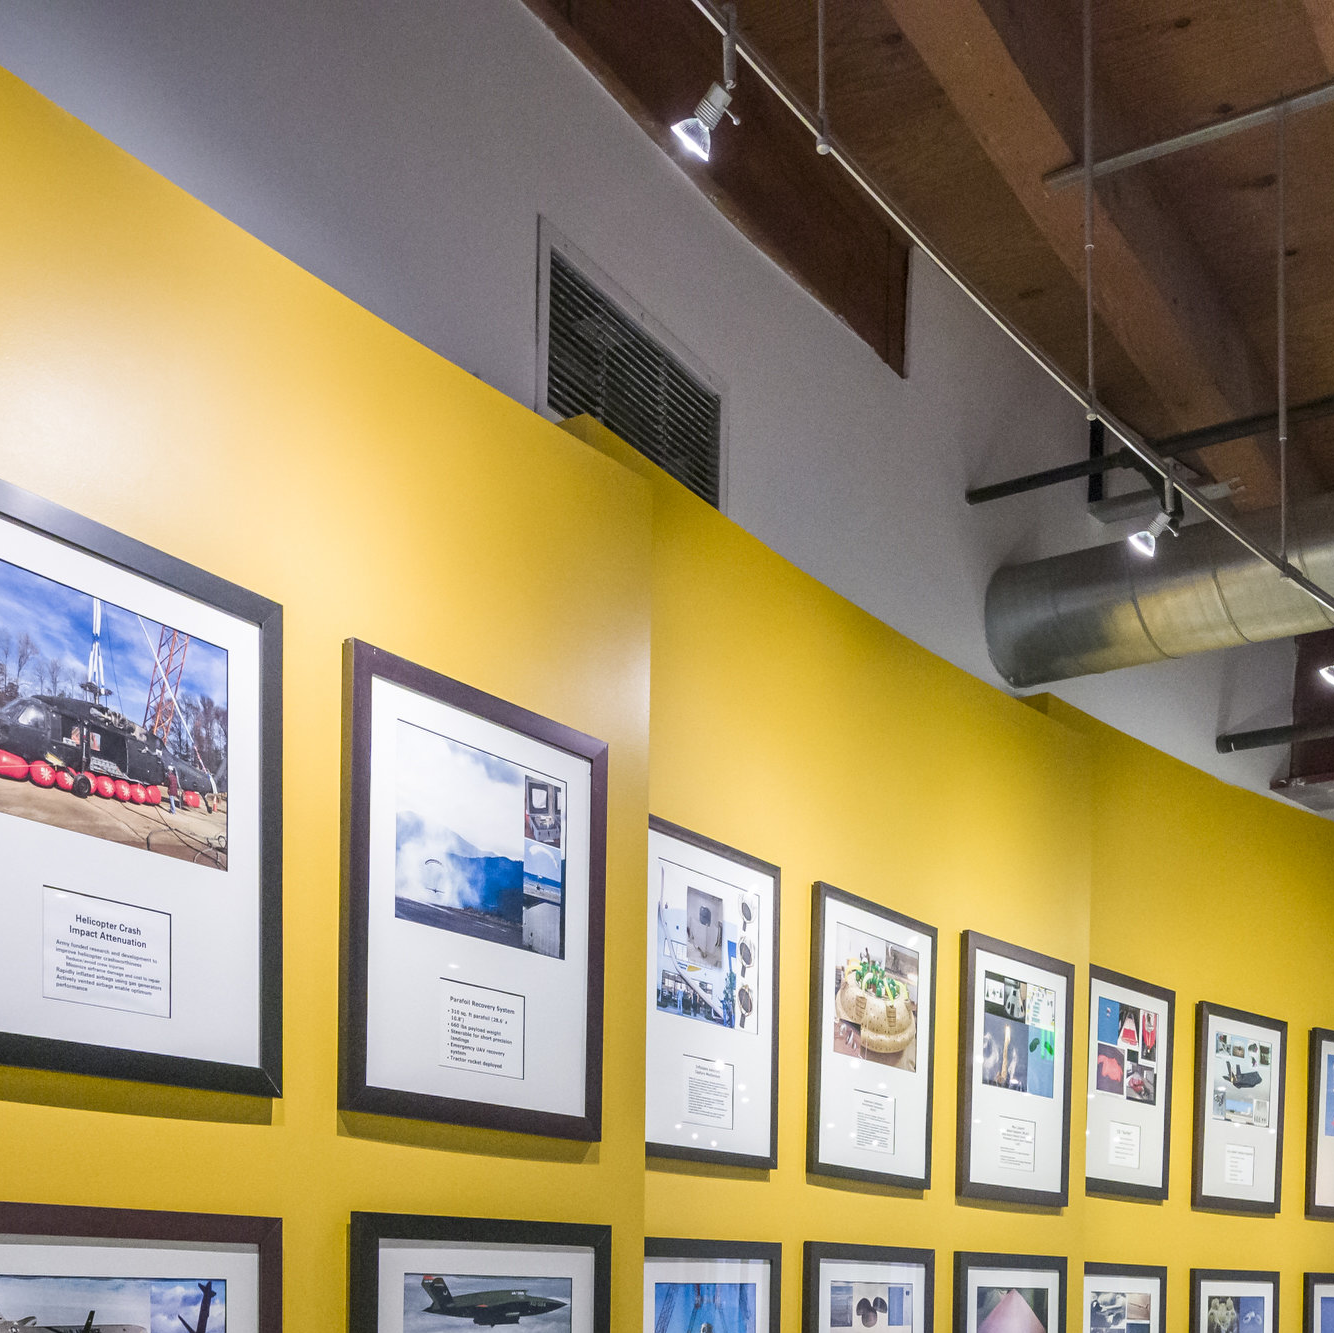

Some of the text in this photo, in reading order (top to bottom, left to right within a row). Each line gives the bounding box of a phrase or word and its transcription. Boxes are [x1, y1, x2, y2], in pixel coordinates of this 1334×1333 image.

[76, 914, 141, 935] Helicopter Crash
[70, 925, 146, 948] Impact Attenuation
[450, 996, 515, 1014] Parafoil Recovery System
